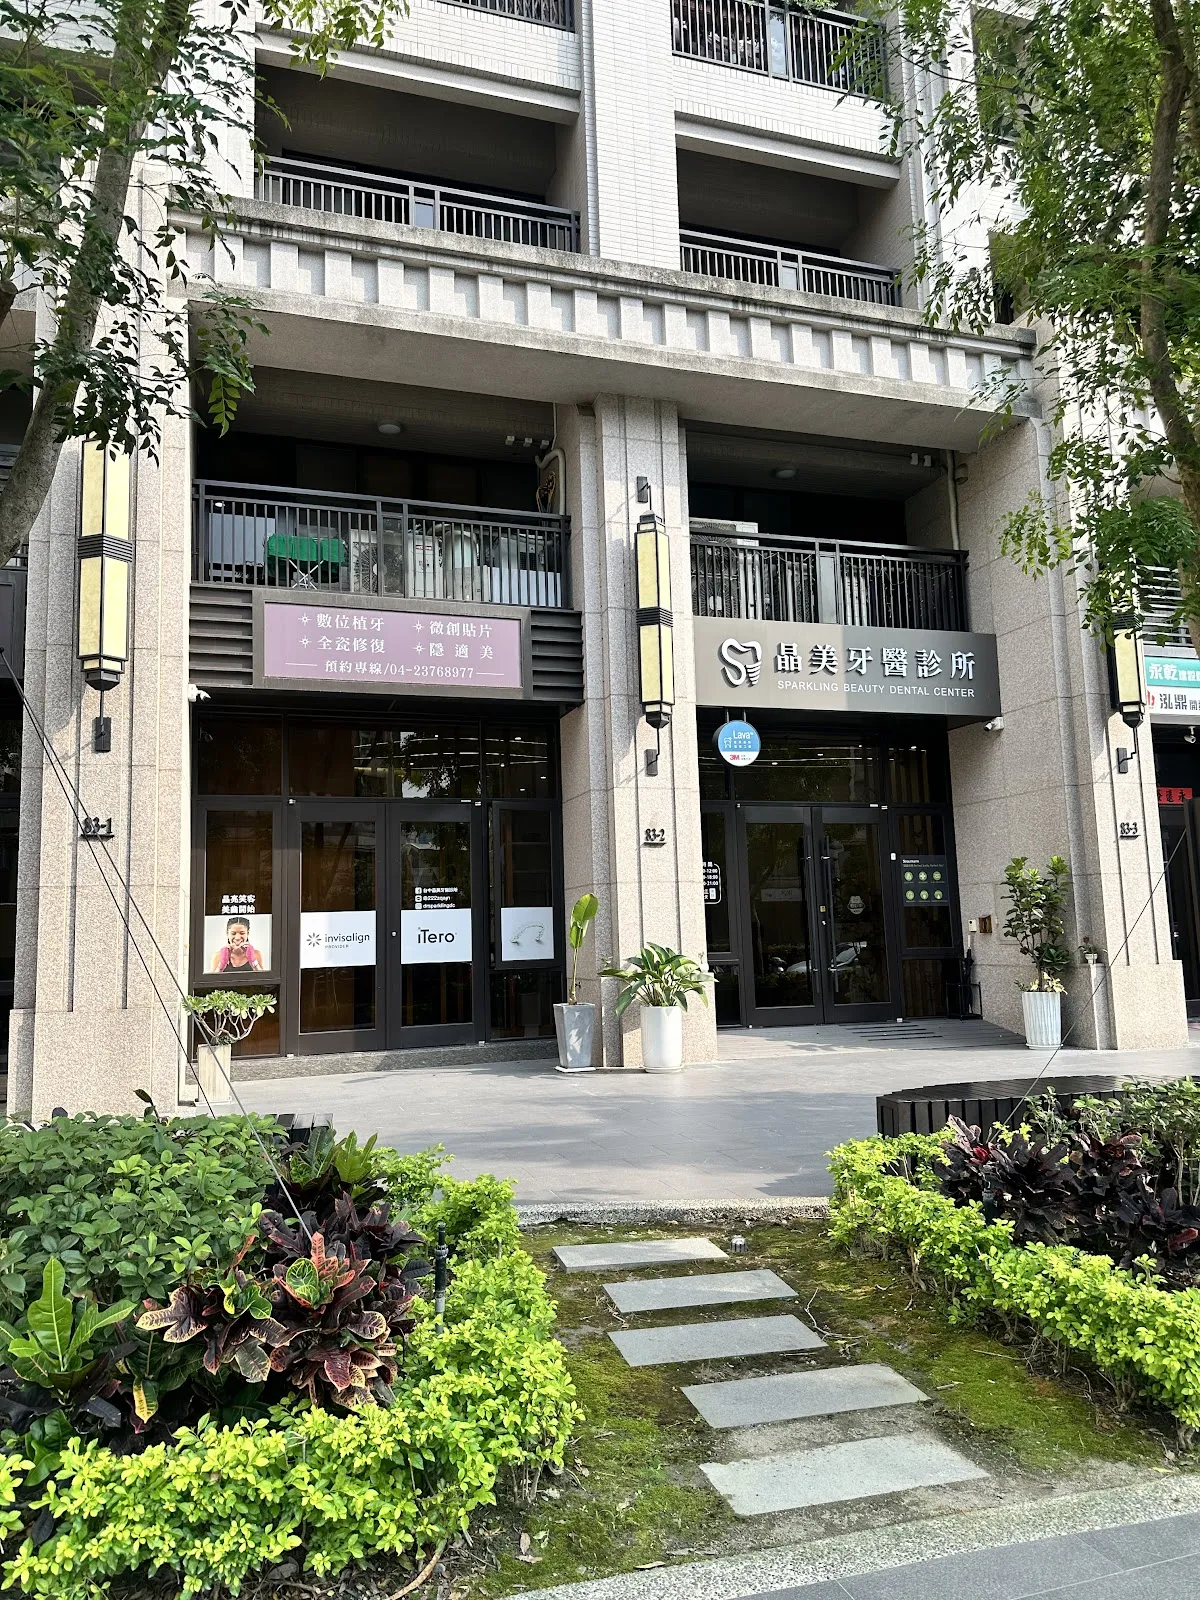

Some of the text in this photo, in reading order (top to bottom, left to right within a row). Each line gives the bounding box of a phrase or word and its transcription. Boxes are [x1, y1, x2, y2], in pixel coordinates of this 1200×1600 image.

[316, 613, 385, 632] 數位植牙
[429, 620, 493, 638] 微創貼片
[317, 636, 386, 654] 全瓷修復
[429, 642, 494, 660] 隱適美
[776, 642, 976, 681] 晶美牙醫診所
[777, 680, 975, 698] SPARKLING BEAUTY DENTAL CENTER
[1159, 693, 1200, 711] 泓鼎開
[82, 816, 112, 834] 83-1
[1120, 821, 1138, 835] 83-3
[644, 828, 665, 842] 83-2
[325, 932, 370, 944] invisalign
[417, 927, 455, 944] iTero
